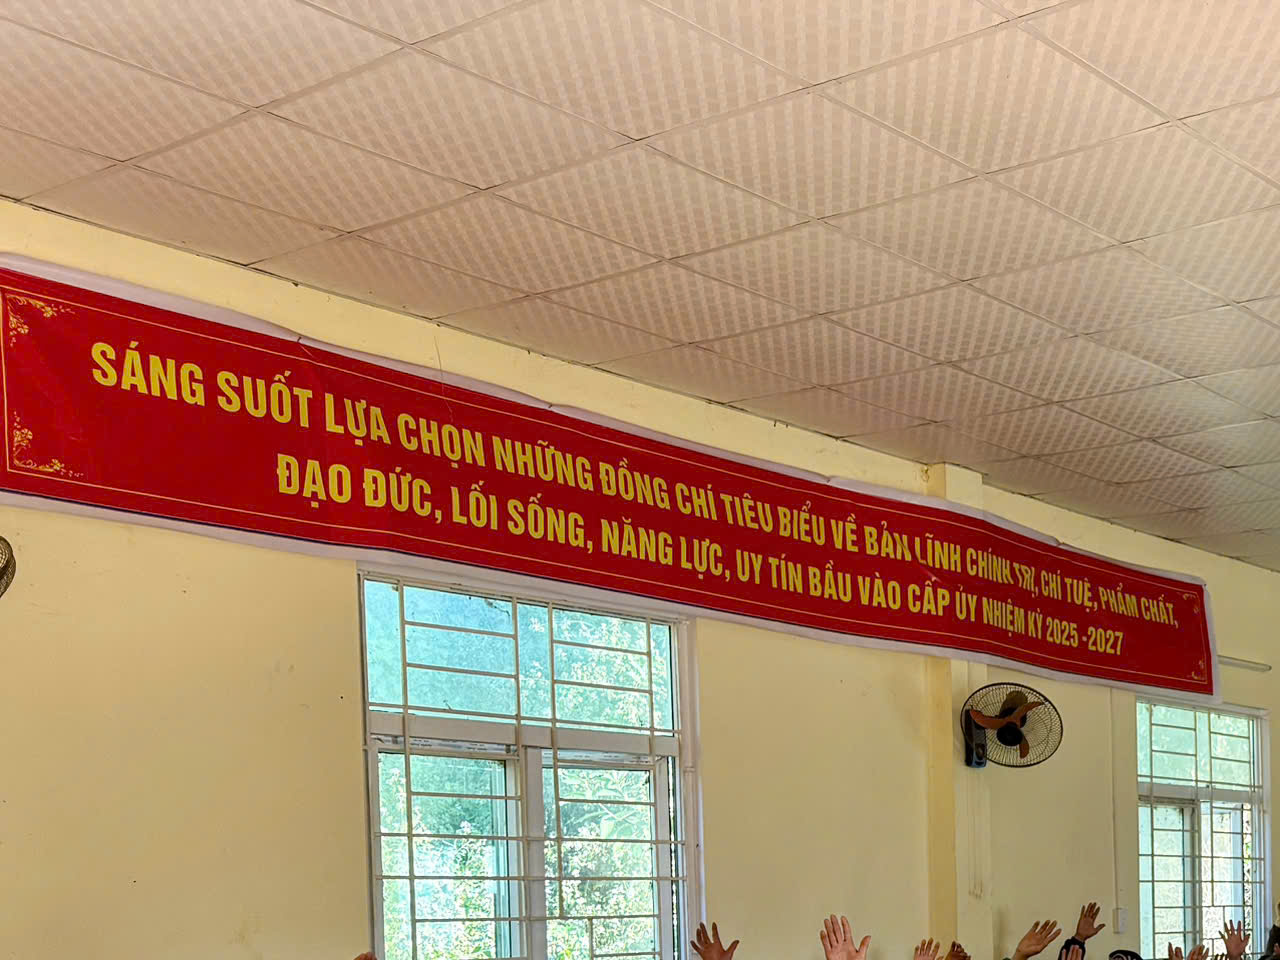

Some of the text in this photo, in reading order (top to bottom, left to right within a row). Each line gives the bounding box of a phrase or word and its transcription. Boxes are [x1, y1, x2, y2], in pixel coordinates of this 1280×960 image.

[91, 341, 206, 407] SÁNG
[217, 370, 313, 428] SUỐT
[325, 393, 392, 446] LỰA
[397, 413, 485, 468] CHỌN
[492, 440, 594, 492] NHỮNG
[599, 457, 671, 510] ĐỒNG
[675, 483, 718, 521] CHÍ
[720, 492, 773, 533] TIÊU
[777, 500, 826, 546] BIỂU
[830, 512, 860, 552] VỀ
[864, 520, 912, 562] BẢN
[966, 547, 1014, 585] CHÍNH
[1040, 569, 1063, 601] CHÍ
[1098, 582, 1140, 618] PHẨM
[277, 453, 352, 509] ĐẠO
[363, 466, 442, 523] ĐỨC,
[451, 480, 498, 530] LỐI
[507, 493, 594, 554] SỐNG,
[601, 516, 673, 570] NĂNG
[679, 535, 731, 582] LỰC,
[735, 548, 763, 584] UY
[768, 553, 803, 593] TÍN
[808, 559, 852, 602] BẦU
[857, 571, 901, 611] VÀO
[907, 576, 950, 617] CẤP
[955, 584, 978, 622] ỦY
[982, 598, 1025, 637] NHIỆM
[1027, 609, 1043, 640] KỲ
[1046, 616, 1079, 648] 2025
